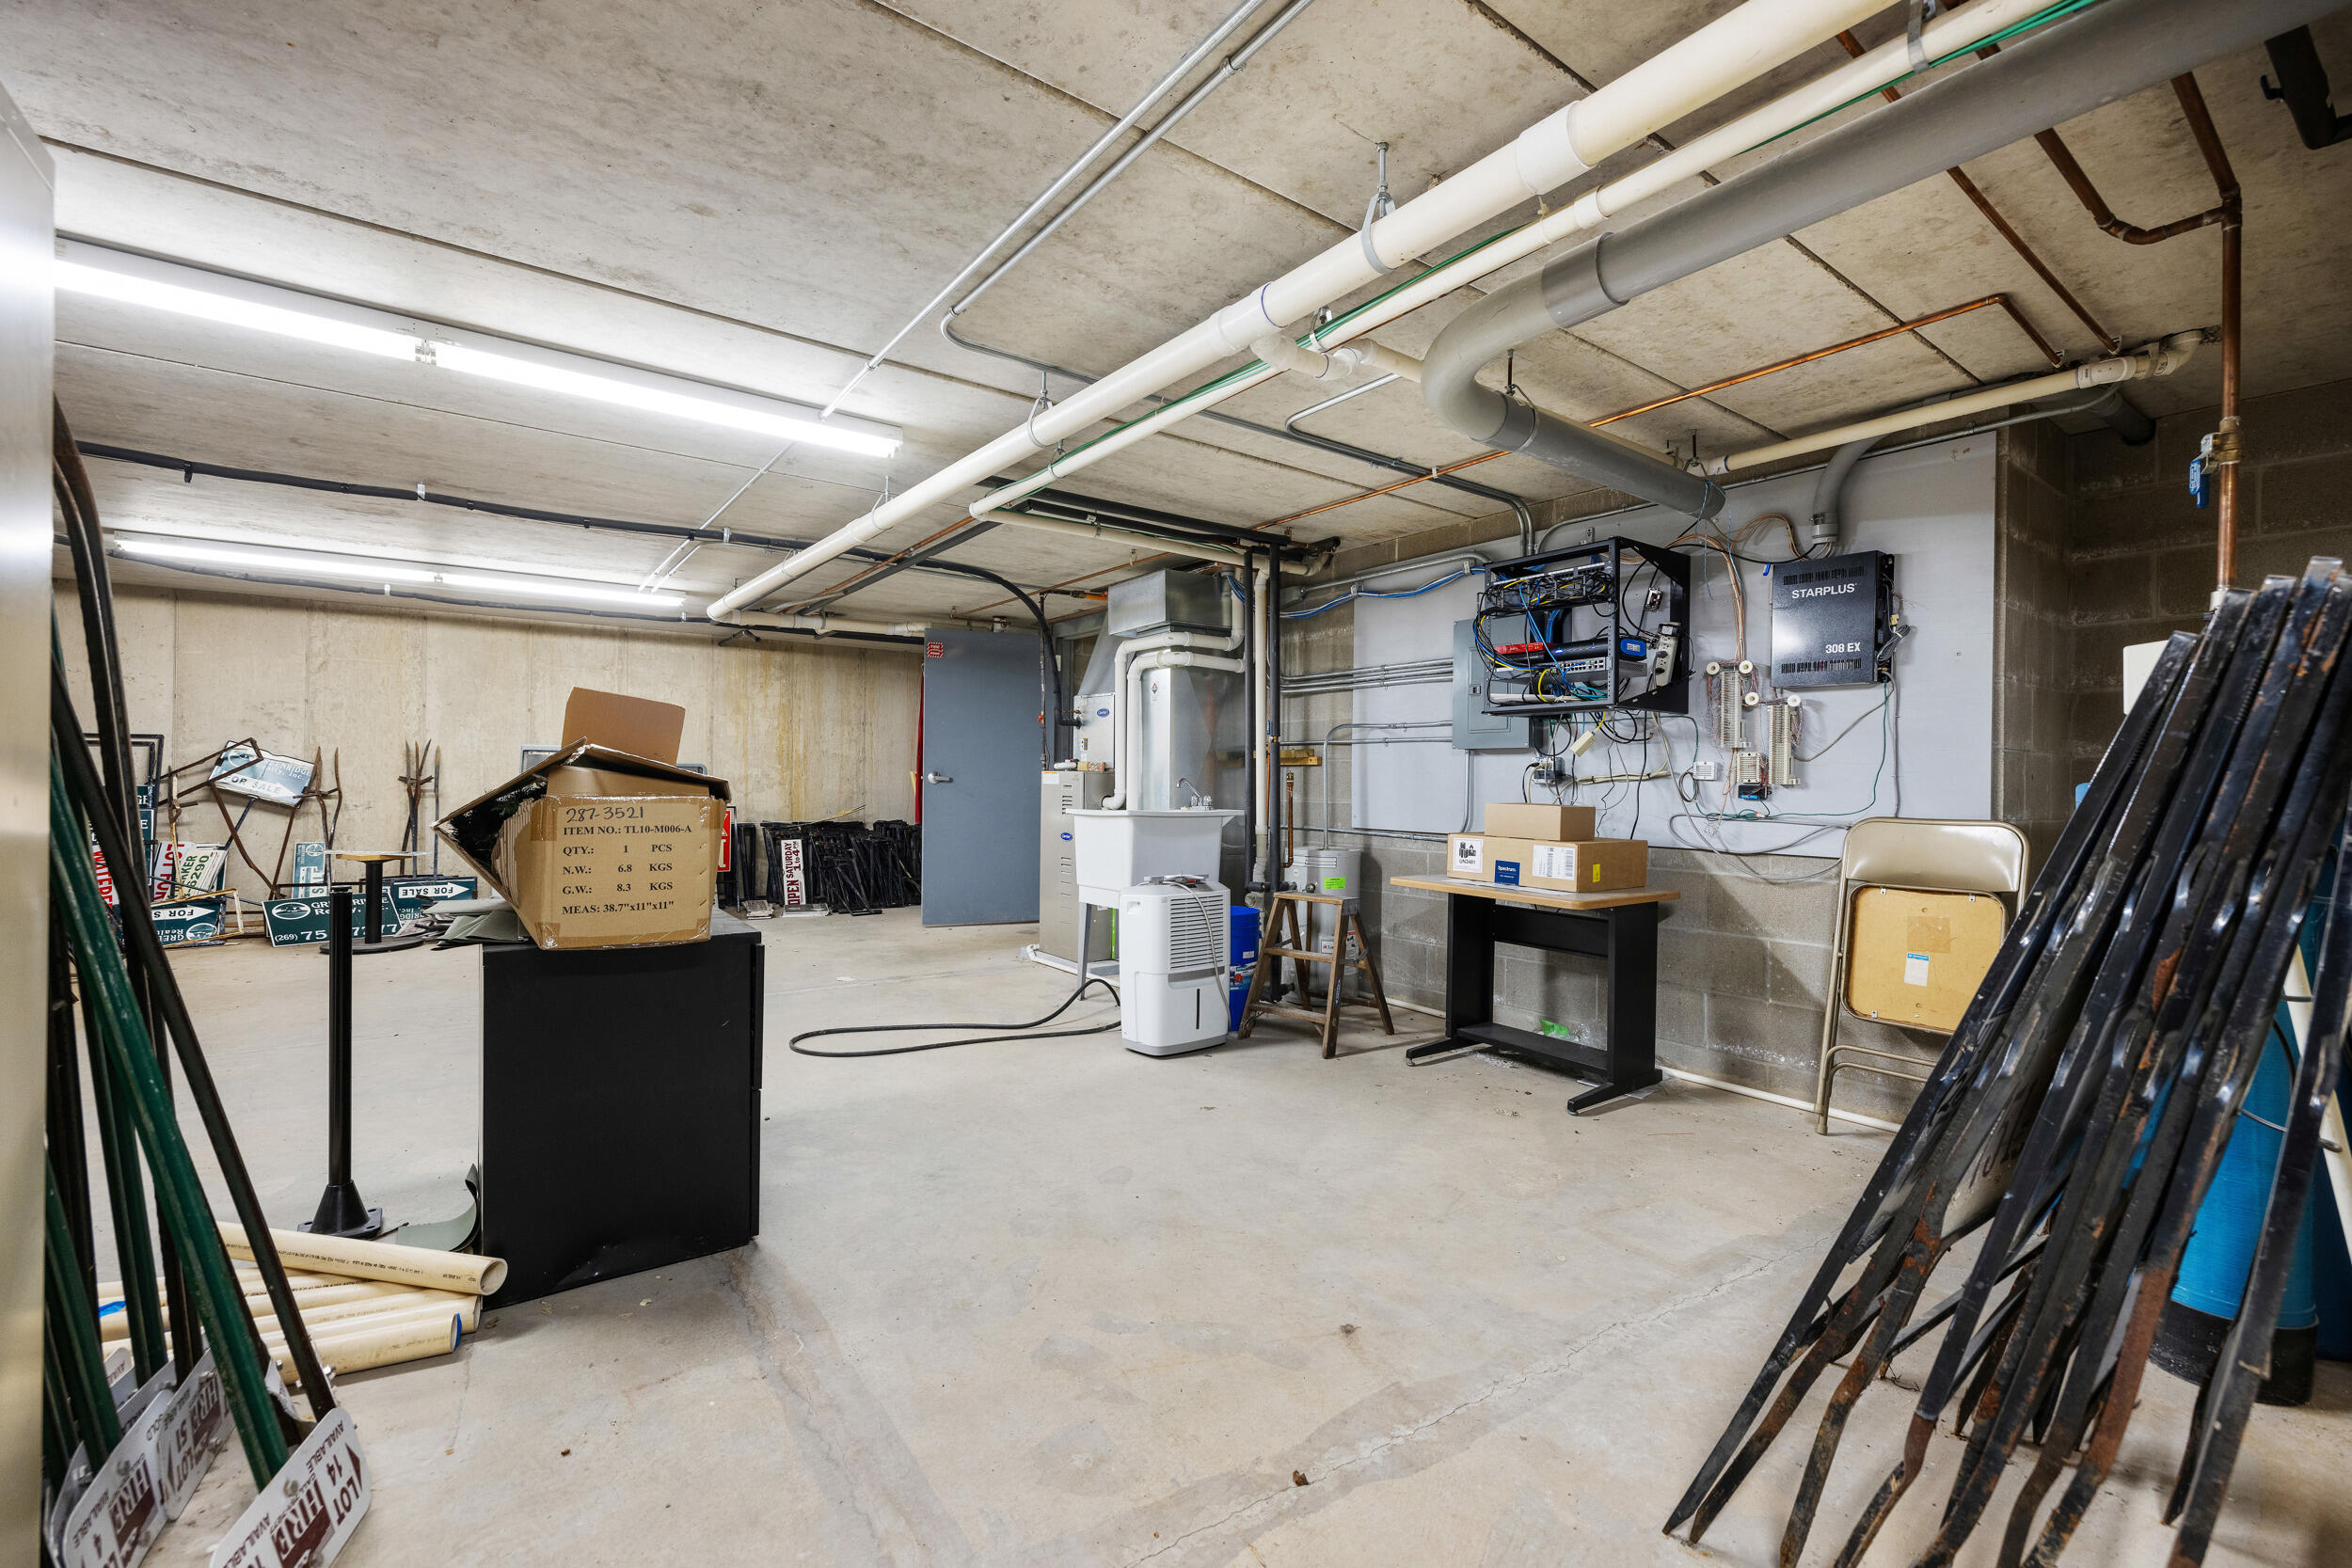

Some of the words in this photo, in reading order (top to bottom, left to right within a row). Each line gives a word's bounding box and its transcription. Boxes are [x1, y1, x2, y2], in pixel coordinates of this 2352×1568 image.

[1791, 583, 1855, 599] STARPLUS
[1825, 643, 1845, 654] 308
[1847, 641, 1861, 652] EX
[565, 806, 644, 823] 287-3521
[564, 827, 595, 835] ITEM
[597, 826, 621, 834] NO.:
[625, 824, 691, 834] TL10-M006-A
[563, 846, 594, 856] QTY.:
[624, 845, 628, 853] 1
[651, 844, 673, 852] PCS
[792, 848, 800, 857] 4
[784, 842, 794, 879] SATURDAY
[563, 865, 592, 875] N.W.:
[617, 864, 632, 873] 6.8
[649, 863, 673, 872] KGS
[792, 863, 802, 872] 1
[402, 888, 429, 896] SALE
[562, 885, 592, 895] G.W.:
[616, 883, 631, 892] 8.3
[649, 882, 673, 891] KGS
[787, 879, 801, 906] OPEN
[168, 909, 195, 917] FOR
[562, 904, 600, 915] MEAS:
[275, 933, 298, 942] (269)
[306, 1419, 344, 1474] AVAILABLE
[326, 1454, 343, 1487] 14
[333, 1475, 360, 1527] LOT
